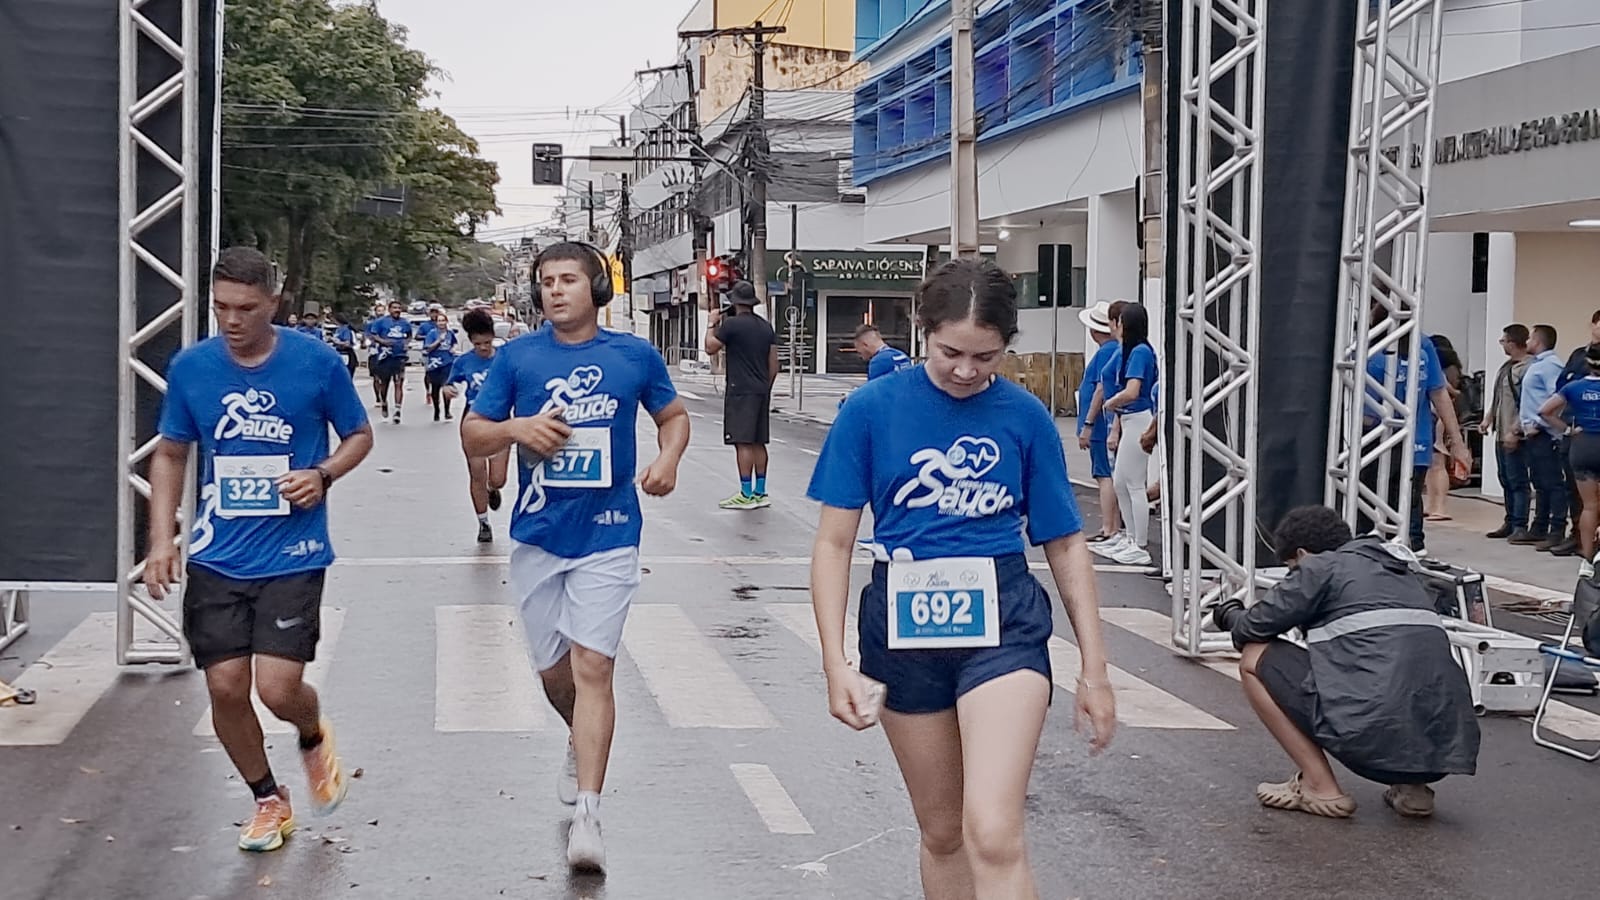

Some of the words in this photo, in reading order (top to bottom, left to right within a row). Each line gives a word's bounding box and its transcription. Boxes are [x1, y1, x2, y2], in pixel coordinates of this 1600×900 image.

[551, 450, 595, 473] 577
[227, 478, 272, 501] 322
[911, 591, 973, 626] 692
